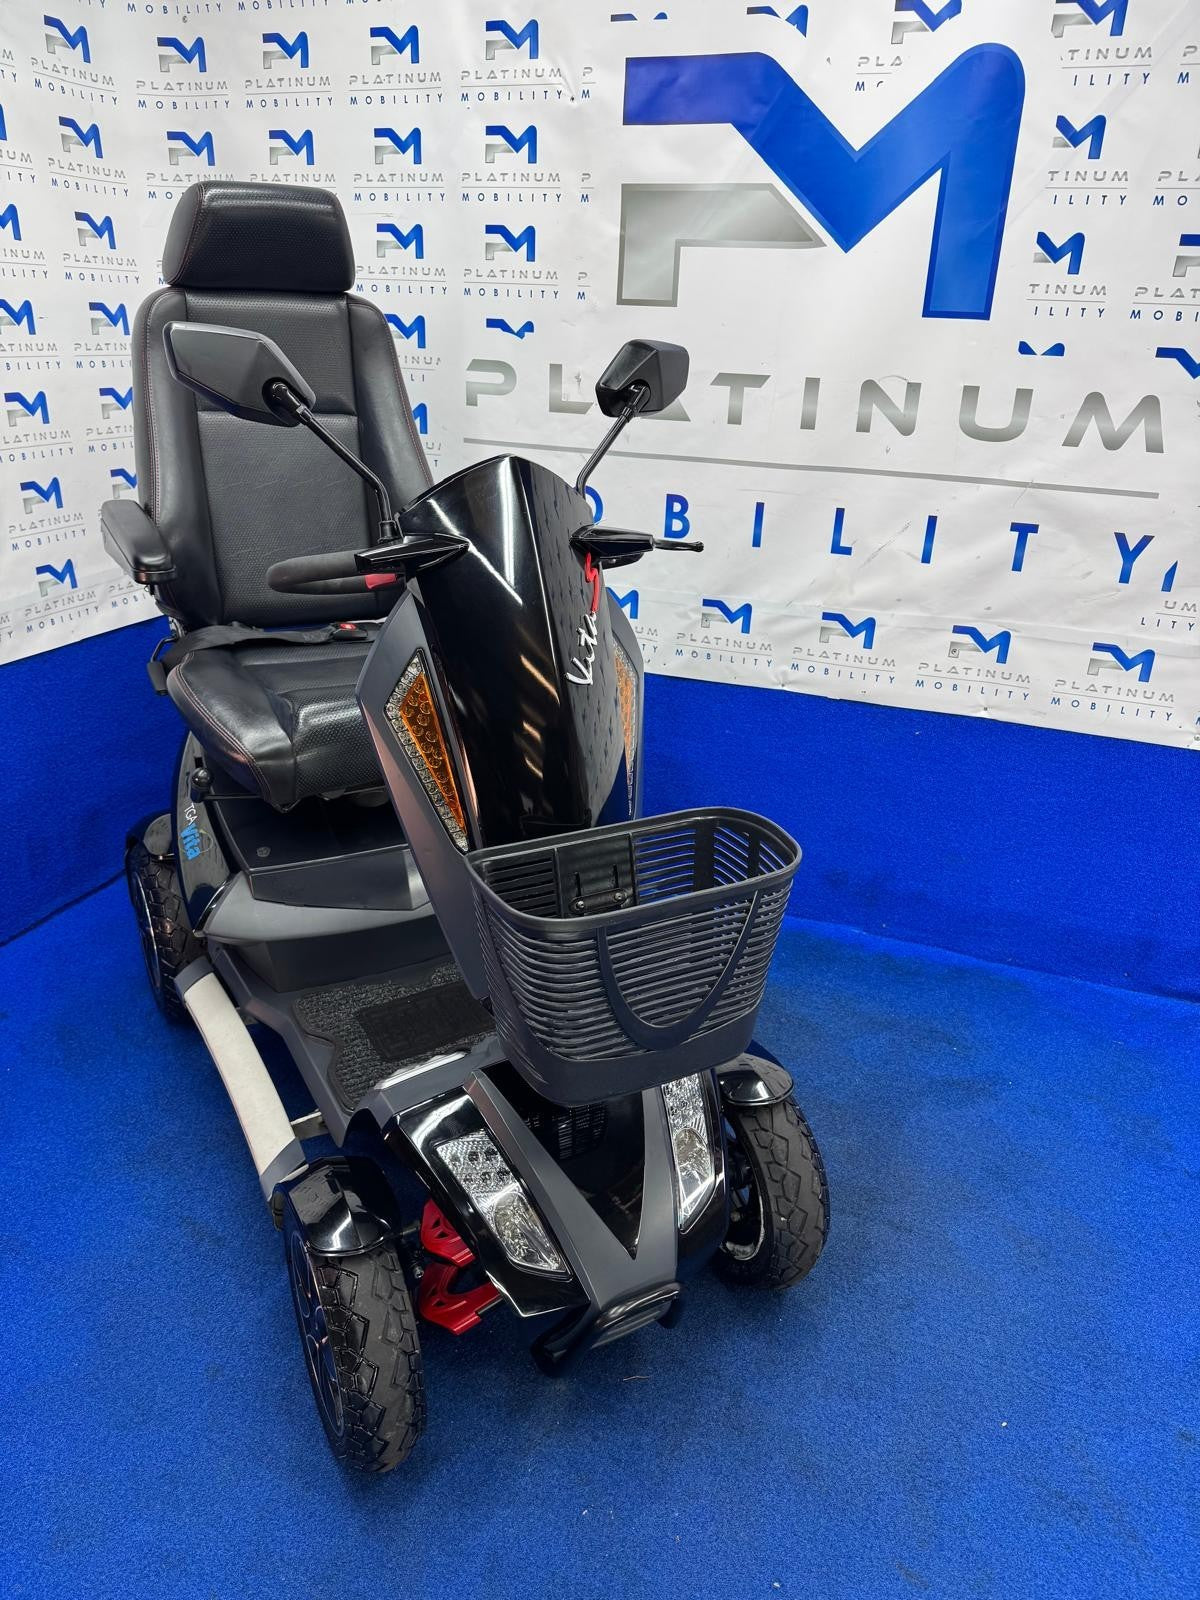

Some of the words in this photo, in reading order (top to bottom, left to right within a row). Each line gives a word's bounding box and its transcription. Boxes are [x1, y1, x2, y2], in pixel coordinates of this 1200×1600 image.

[127, 2, 222, 14] MOBILITY
[1066, 47, 1152, 60] TINUM
[30, 57, 114, 86] PLATINUM
[461, 67, 562, 81] PLATINUM
[245, 75, 331, 89] PLATINUM
[349, 71, 441, 86] PLATINUM
[1073, 73, 1150, 86] ILITY
[34, 78, 117, 105] MOBILITY
[136, 80, 228, 91] PLATINUM
[350, 93, 442, 106] MOBILITY
[461, 89, 562, 102] MOBILITY
[138, 99, 230, 110] MOBILITY
[246, 97, 333, 108] MOBILITY
[48, 157, 126, 179] PLATINUM
[250, 173, 336, 182] PLATINUM
[353, 172, 444, 183] PLATINUM
[461, 172, 561, 183] PLATINUM
[1048, 170, 1128, 182] TINUM
[51, 178, 129, 197] MOBILITY
[354, 192, 446, 202] MOBILITY
[461, 193, 562, 202] MOBILITY
[1053, 194, 1127, 205] ILITY
[63, 252, 137, 267] PLATINUM
[2, 267, 48, 279] ILITY
[64, 271, 140, 284] MOBILITY
[356, 265, 446, 277] PLATINUM
[464, 268, 558, 280] PLATINUM
[356, 284, 448, 295] MOBILITY
[463, 287, 559, 299] MOBILITY
[1029, 283, 1107, 296] TINUM
[1134, 286, 1200, 298] PLAT
[1034, 306, 1105, 318] ILITY
[1130, 309, 1199, 322] MOBI
[0, 343, 58, 352] ATINUM
[74, 342, 129, 352] PLATIN
[5, 361, 61, 371] BILITY
[465, 358, 1165, 453] PLTINUM
[2, 430, 71, 444] LATINUM
[0, 447, 74, 463] OBILITY
[8, 512, 84, 534] PLATINUM
[11, 528, 87, 551] MOBILITY
[24, 590, 96, 617] PLATINUM
[26, 606, 100, 633] MOBILITY
[676, 632, 773, 651] PLATINUM
[675, 648, 773, 668] MOBILITY
[792, 647, 896, 667] PLATINUM
[790, 662, 895, 685] MOBILITY
[918, 662, 1031, 684] PLATINUM
[915, 679, 1030, 701] MOBILITY
[1054, 679, 1175, 703] PLATINUM
[1050, 697, 1172, 721] MOBILITY
[184, 802, 198, 825] TGA
